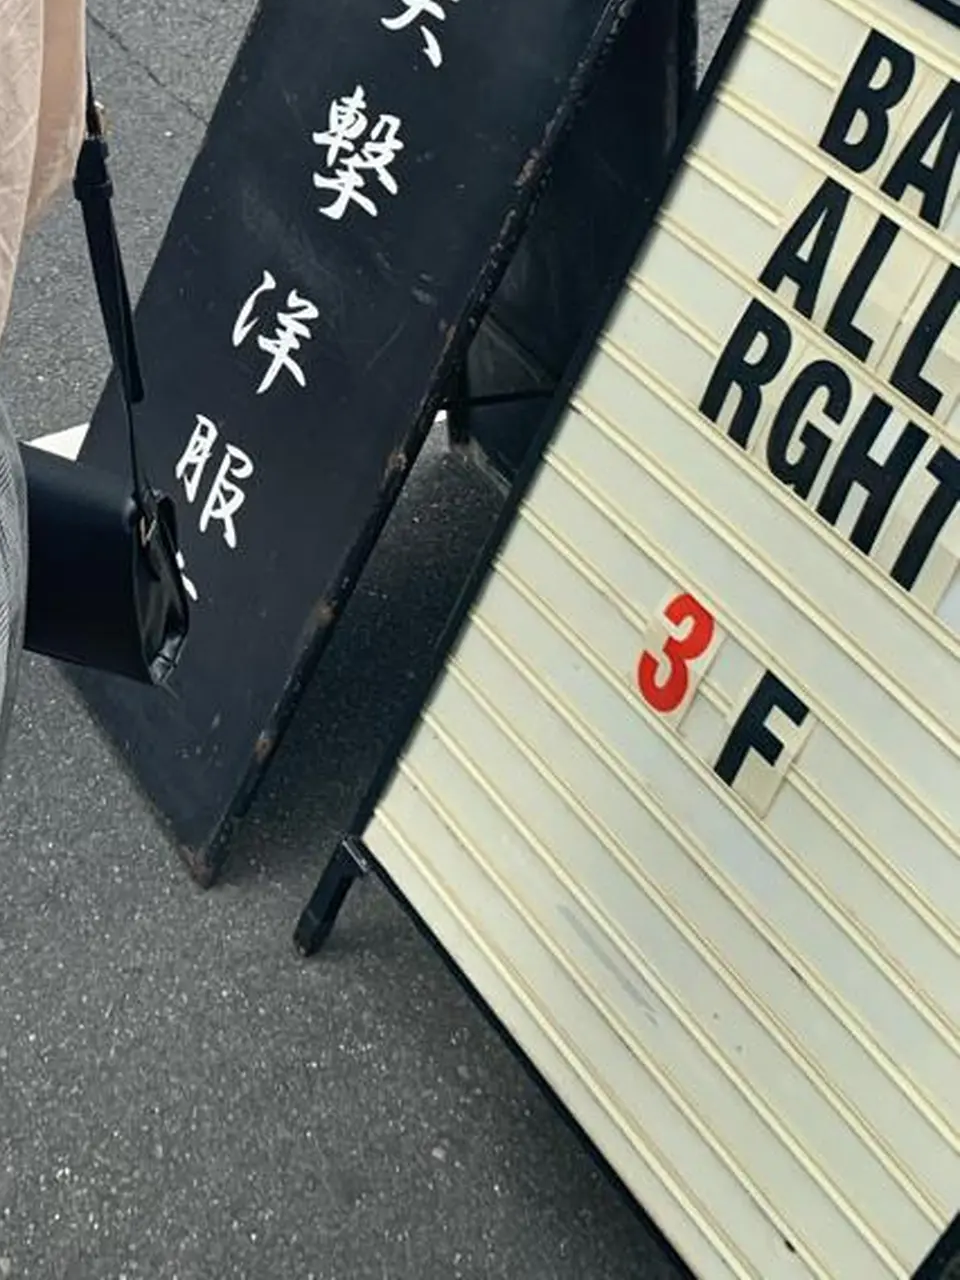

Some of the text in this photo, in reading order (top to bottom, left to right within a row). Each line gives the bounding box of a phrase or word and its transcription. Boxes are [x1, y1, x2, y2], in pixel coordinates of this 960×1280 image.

[818, 28, 960, 229] BA
[757, 176, 960, 417] ALL
[698, 297, 960, 592] RGHT
